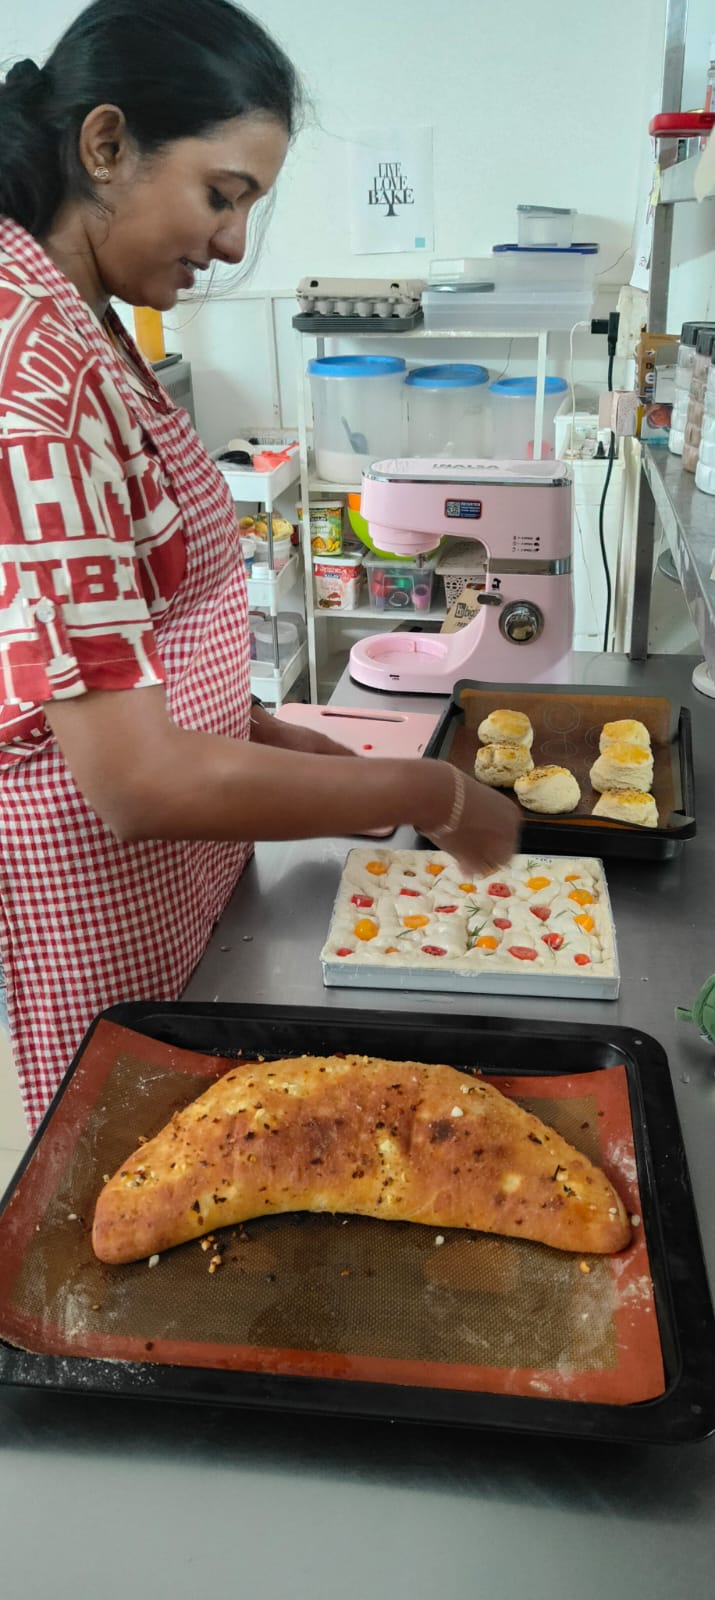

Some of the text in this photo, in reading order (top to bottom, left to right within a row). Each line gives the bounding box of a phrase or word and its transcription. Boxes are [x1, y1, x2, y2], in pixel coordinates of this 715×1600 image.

[378, 162, 402, 178] LIVE
[374, 174, 408, 191] LOVE
[368, 188, 415, 205] BAKE
